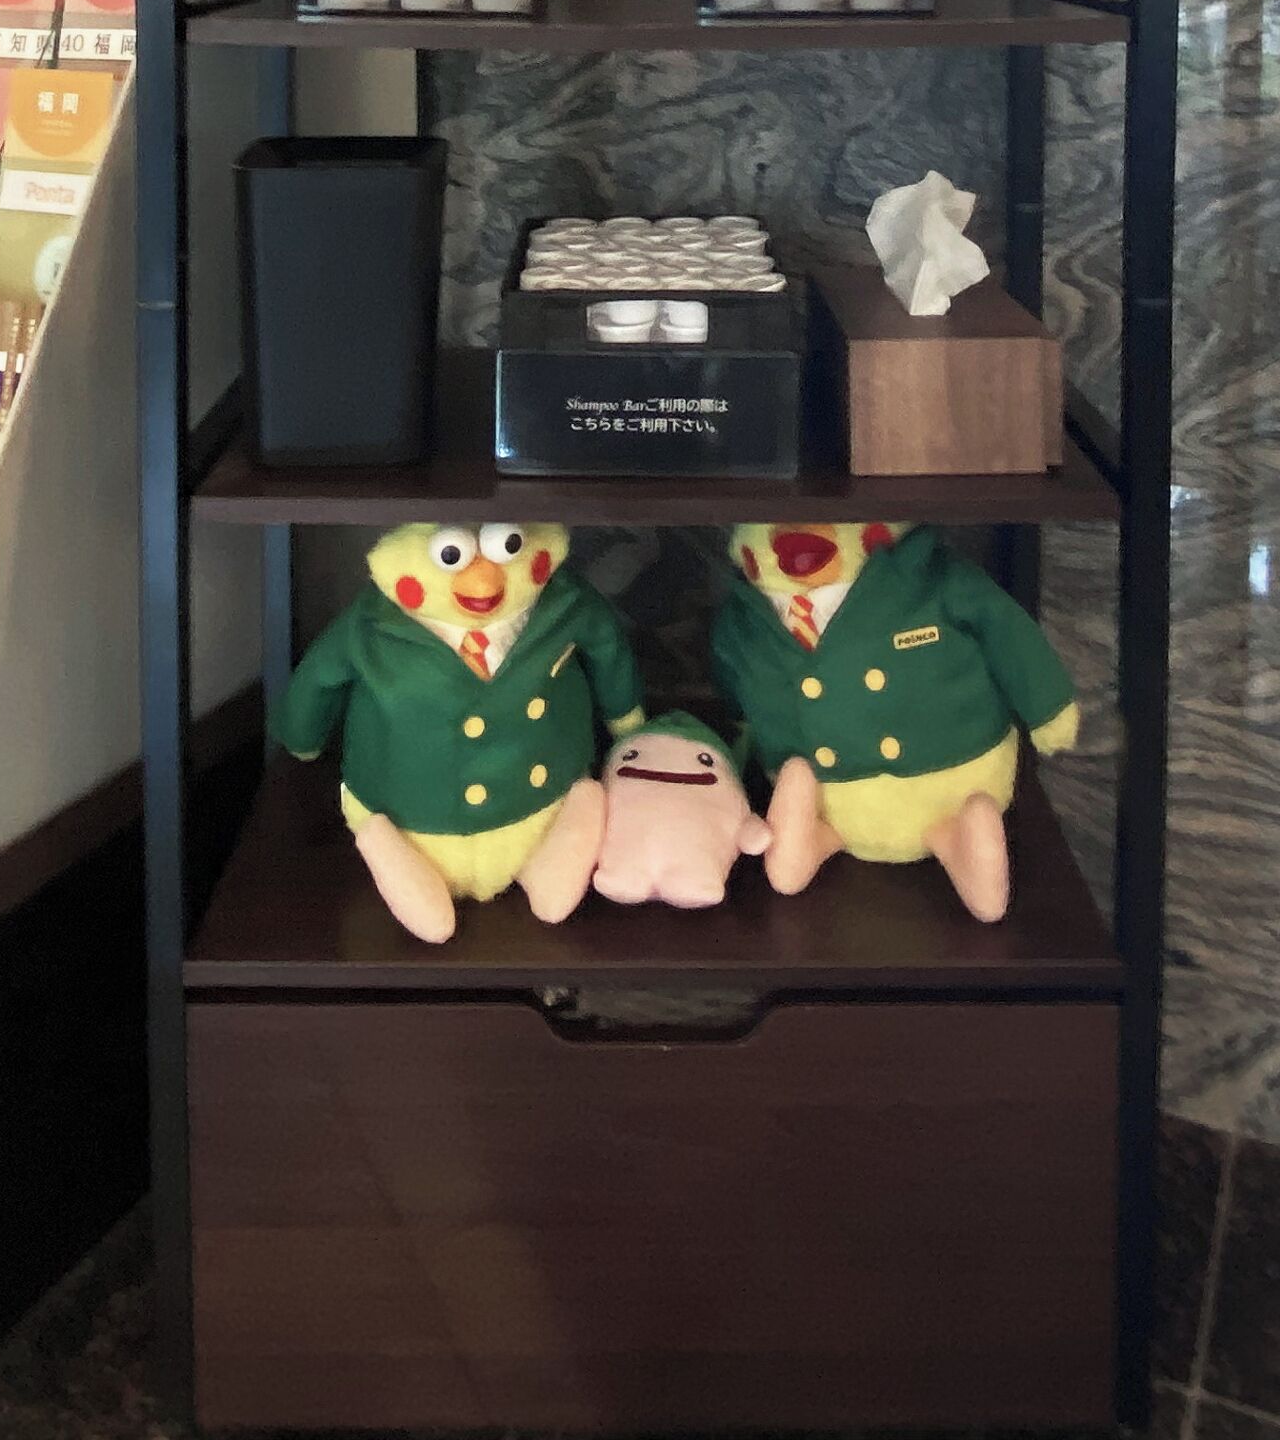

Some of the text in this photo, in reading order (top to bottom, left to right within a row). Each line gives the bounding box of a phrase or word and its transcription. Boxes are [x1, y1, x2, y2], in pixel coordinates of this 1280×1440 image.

[62, 34, 84, 52] 40
[37, 91, 80, 114] 福岡
[566, 395, 620, 416] Shampoo
[570, 417, 717, 434] こちらをご利用下さい。
